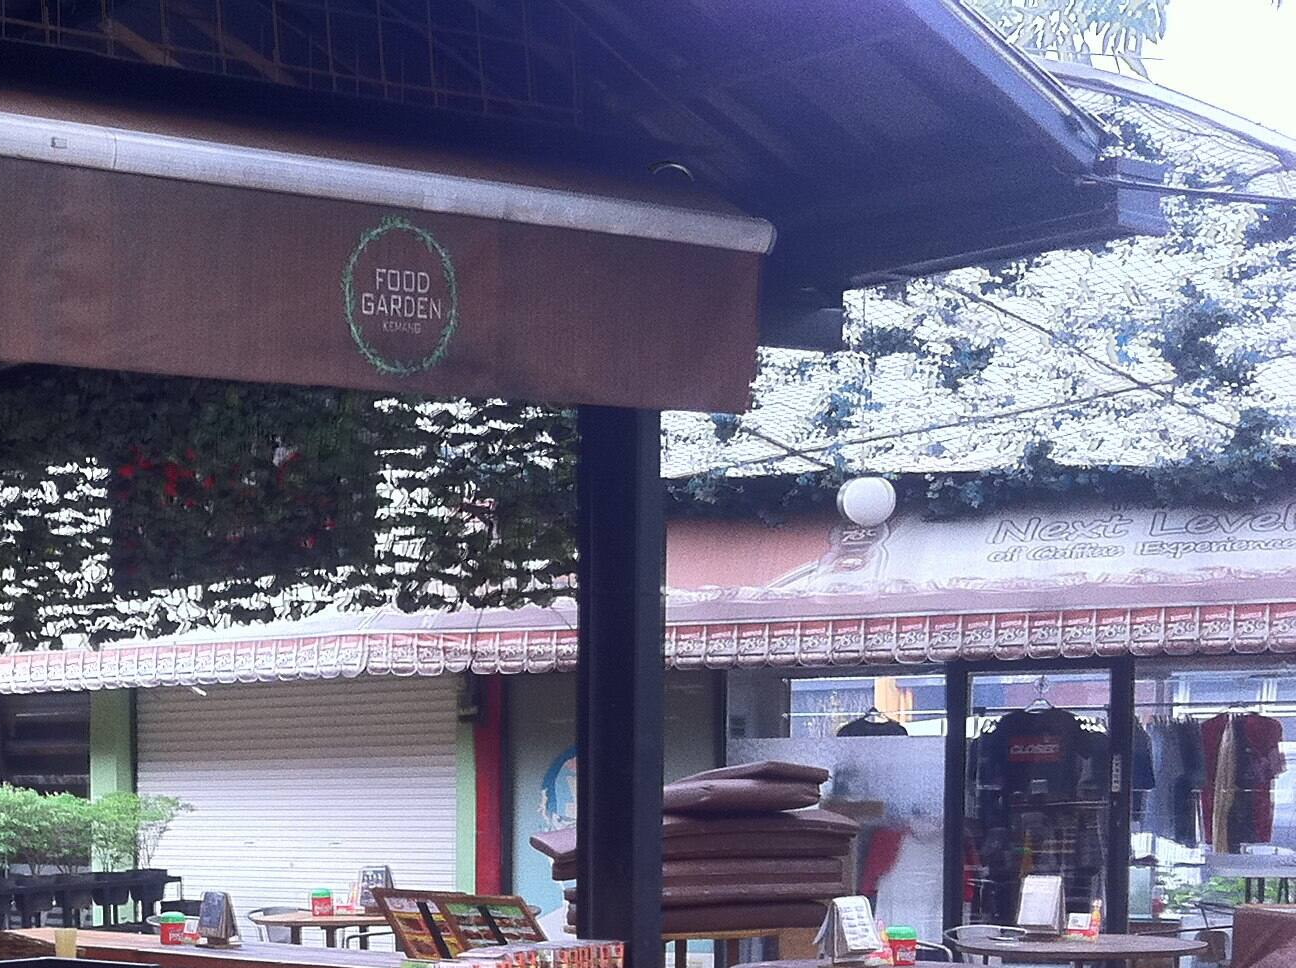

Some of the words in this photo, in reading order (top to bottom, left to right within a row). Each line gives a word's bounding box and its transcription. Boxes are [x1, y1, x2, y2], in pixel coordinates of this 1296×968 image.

[375, 268, 430, 293] FOOD
[361, 292, 442, 320] GARDEN
[382, 320, 422, 335] KEMANG
[985, 513, 1134, 545] Next
[1149, 501, 1296, 538] Level
[987, 545, 1027, 563] of
[1139, 536, 1296, 559] Experience
